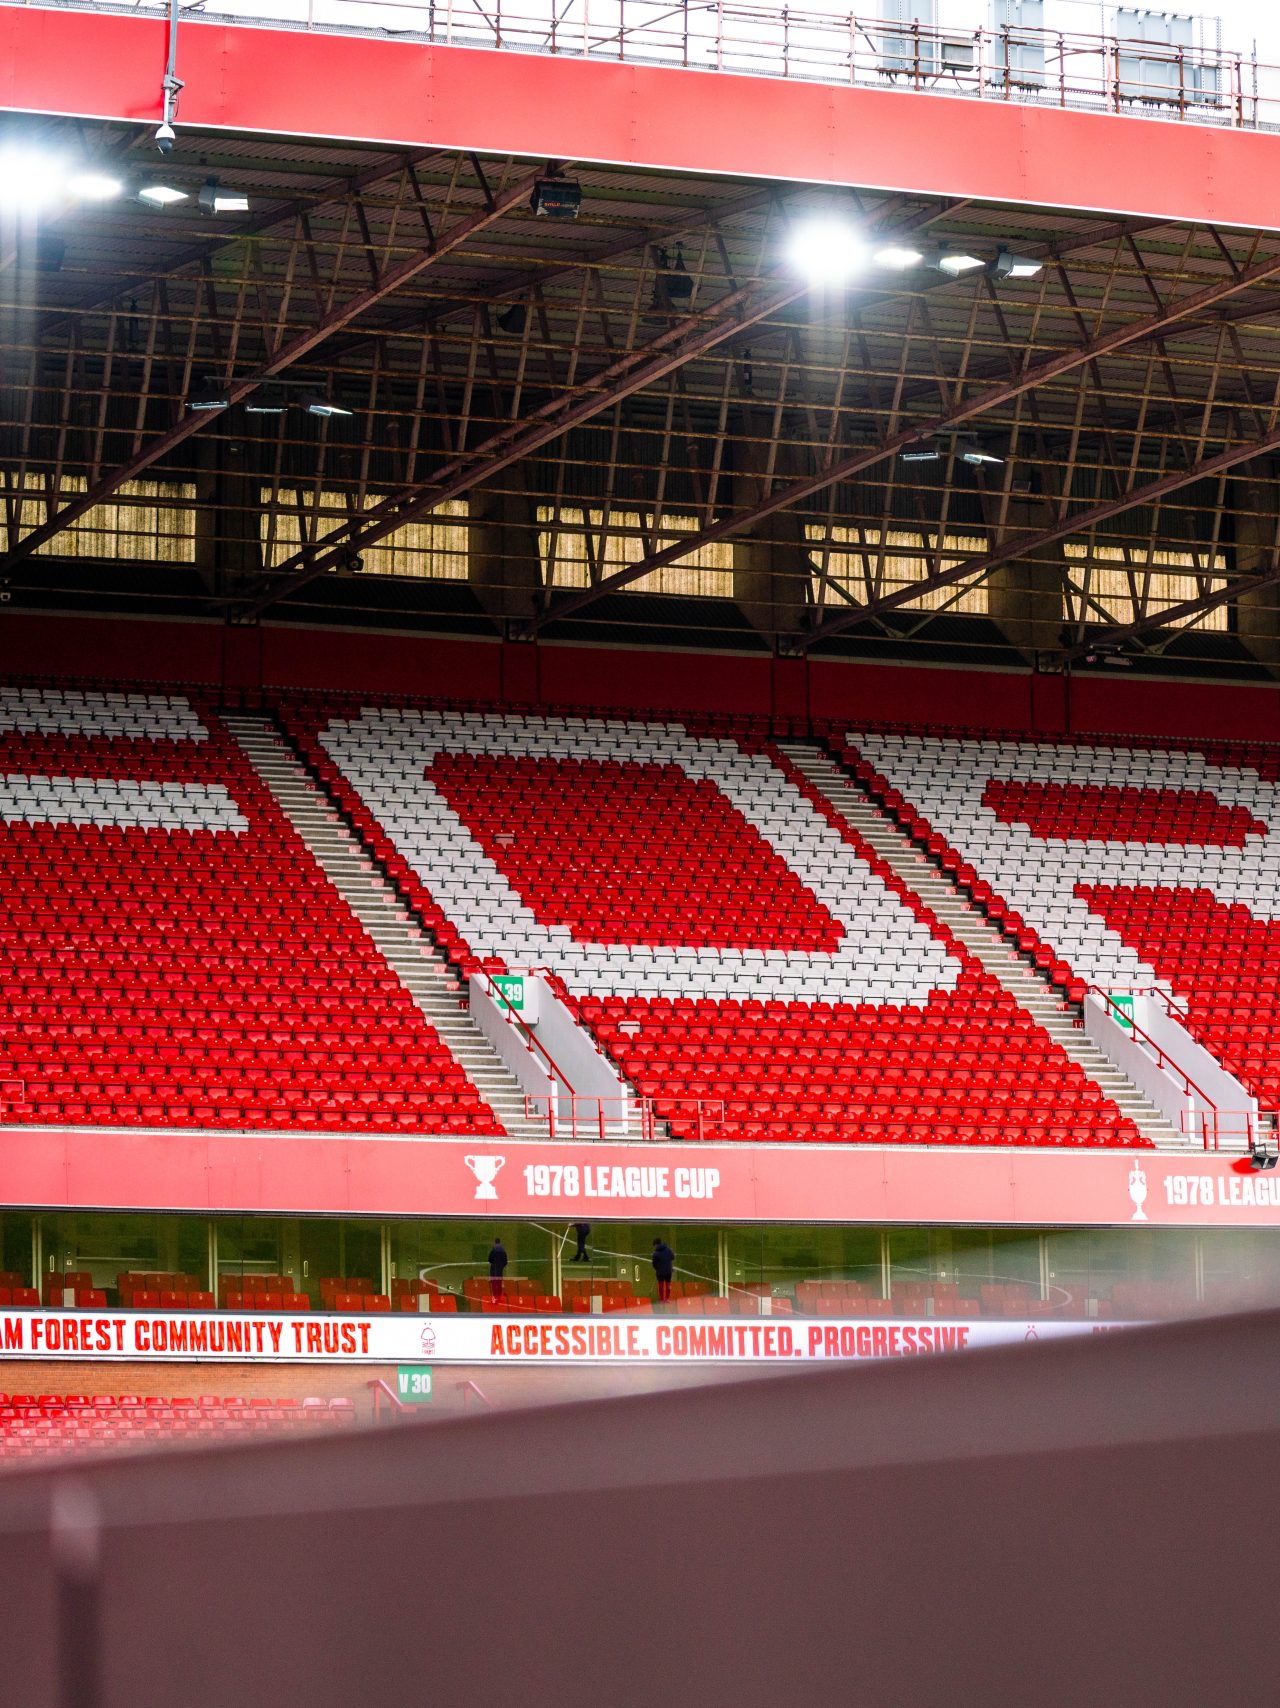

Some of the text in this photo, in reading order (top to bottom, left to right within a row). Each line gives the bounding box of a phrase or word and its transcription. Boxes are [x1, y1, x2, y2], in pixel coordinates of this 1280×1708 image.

[504, 983, 523, 1001] 39
[523, 1164, 720, 1199] 1978 LEAGUE CUP
[1163, 1175, 1213, 1206] 1978
[30, 1318, 127, 1351] FOREST
[134, 1320, 283, 1353] COMMUNITY
[291, 1322, 371, 1354] TRUST
[490, 1324, 970, 1358] ACCESSIBLE. COMMITTED. PROGRESSIVE
[398, 1373, 431, 1394] V 30
